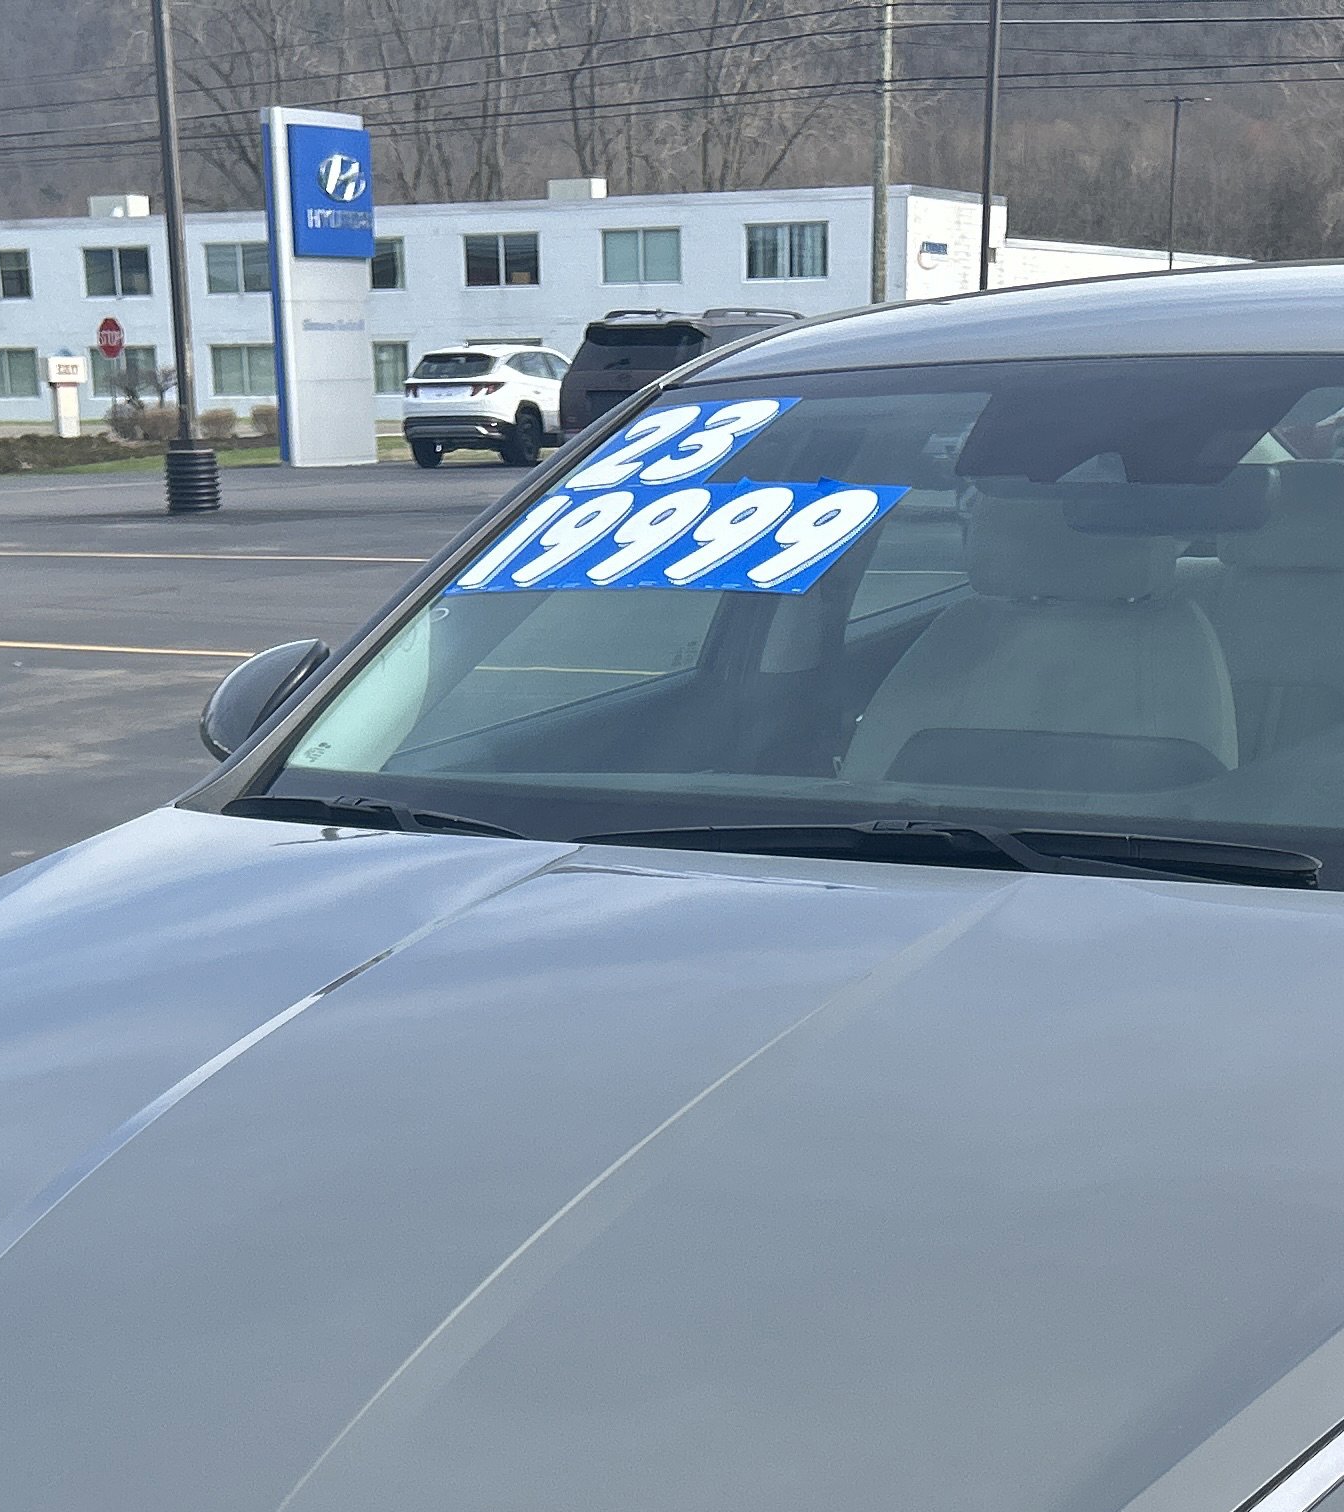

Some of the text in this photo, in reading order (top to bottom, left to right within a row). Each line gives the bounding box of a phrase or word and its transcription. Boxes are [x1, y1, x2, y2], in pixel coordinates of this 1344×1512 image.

[98, 331, 123, 346] STOP
[565, 400, 780, 491] 23
[457, 487, 879, 589] 19999
